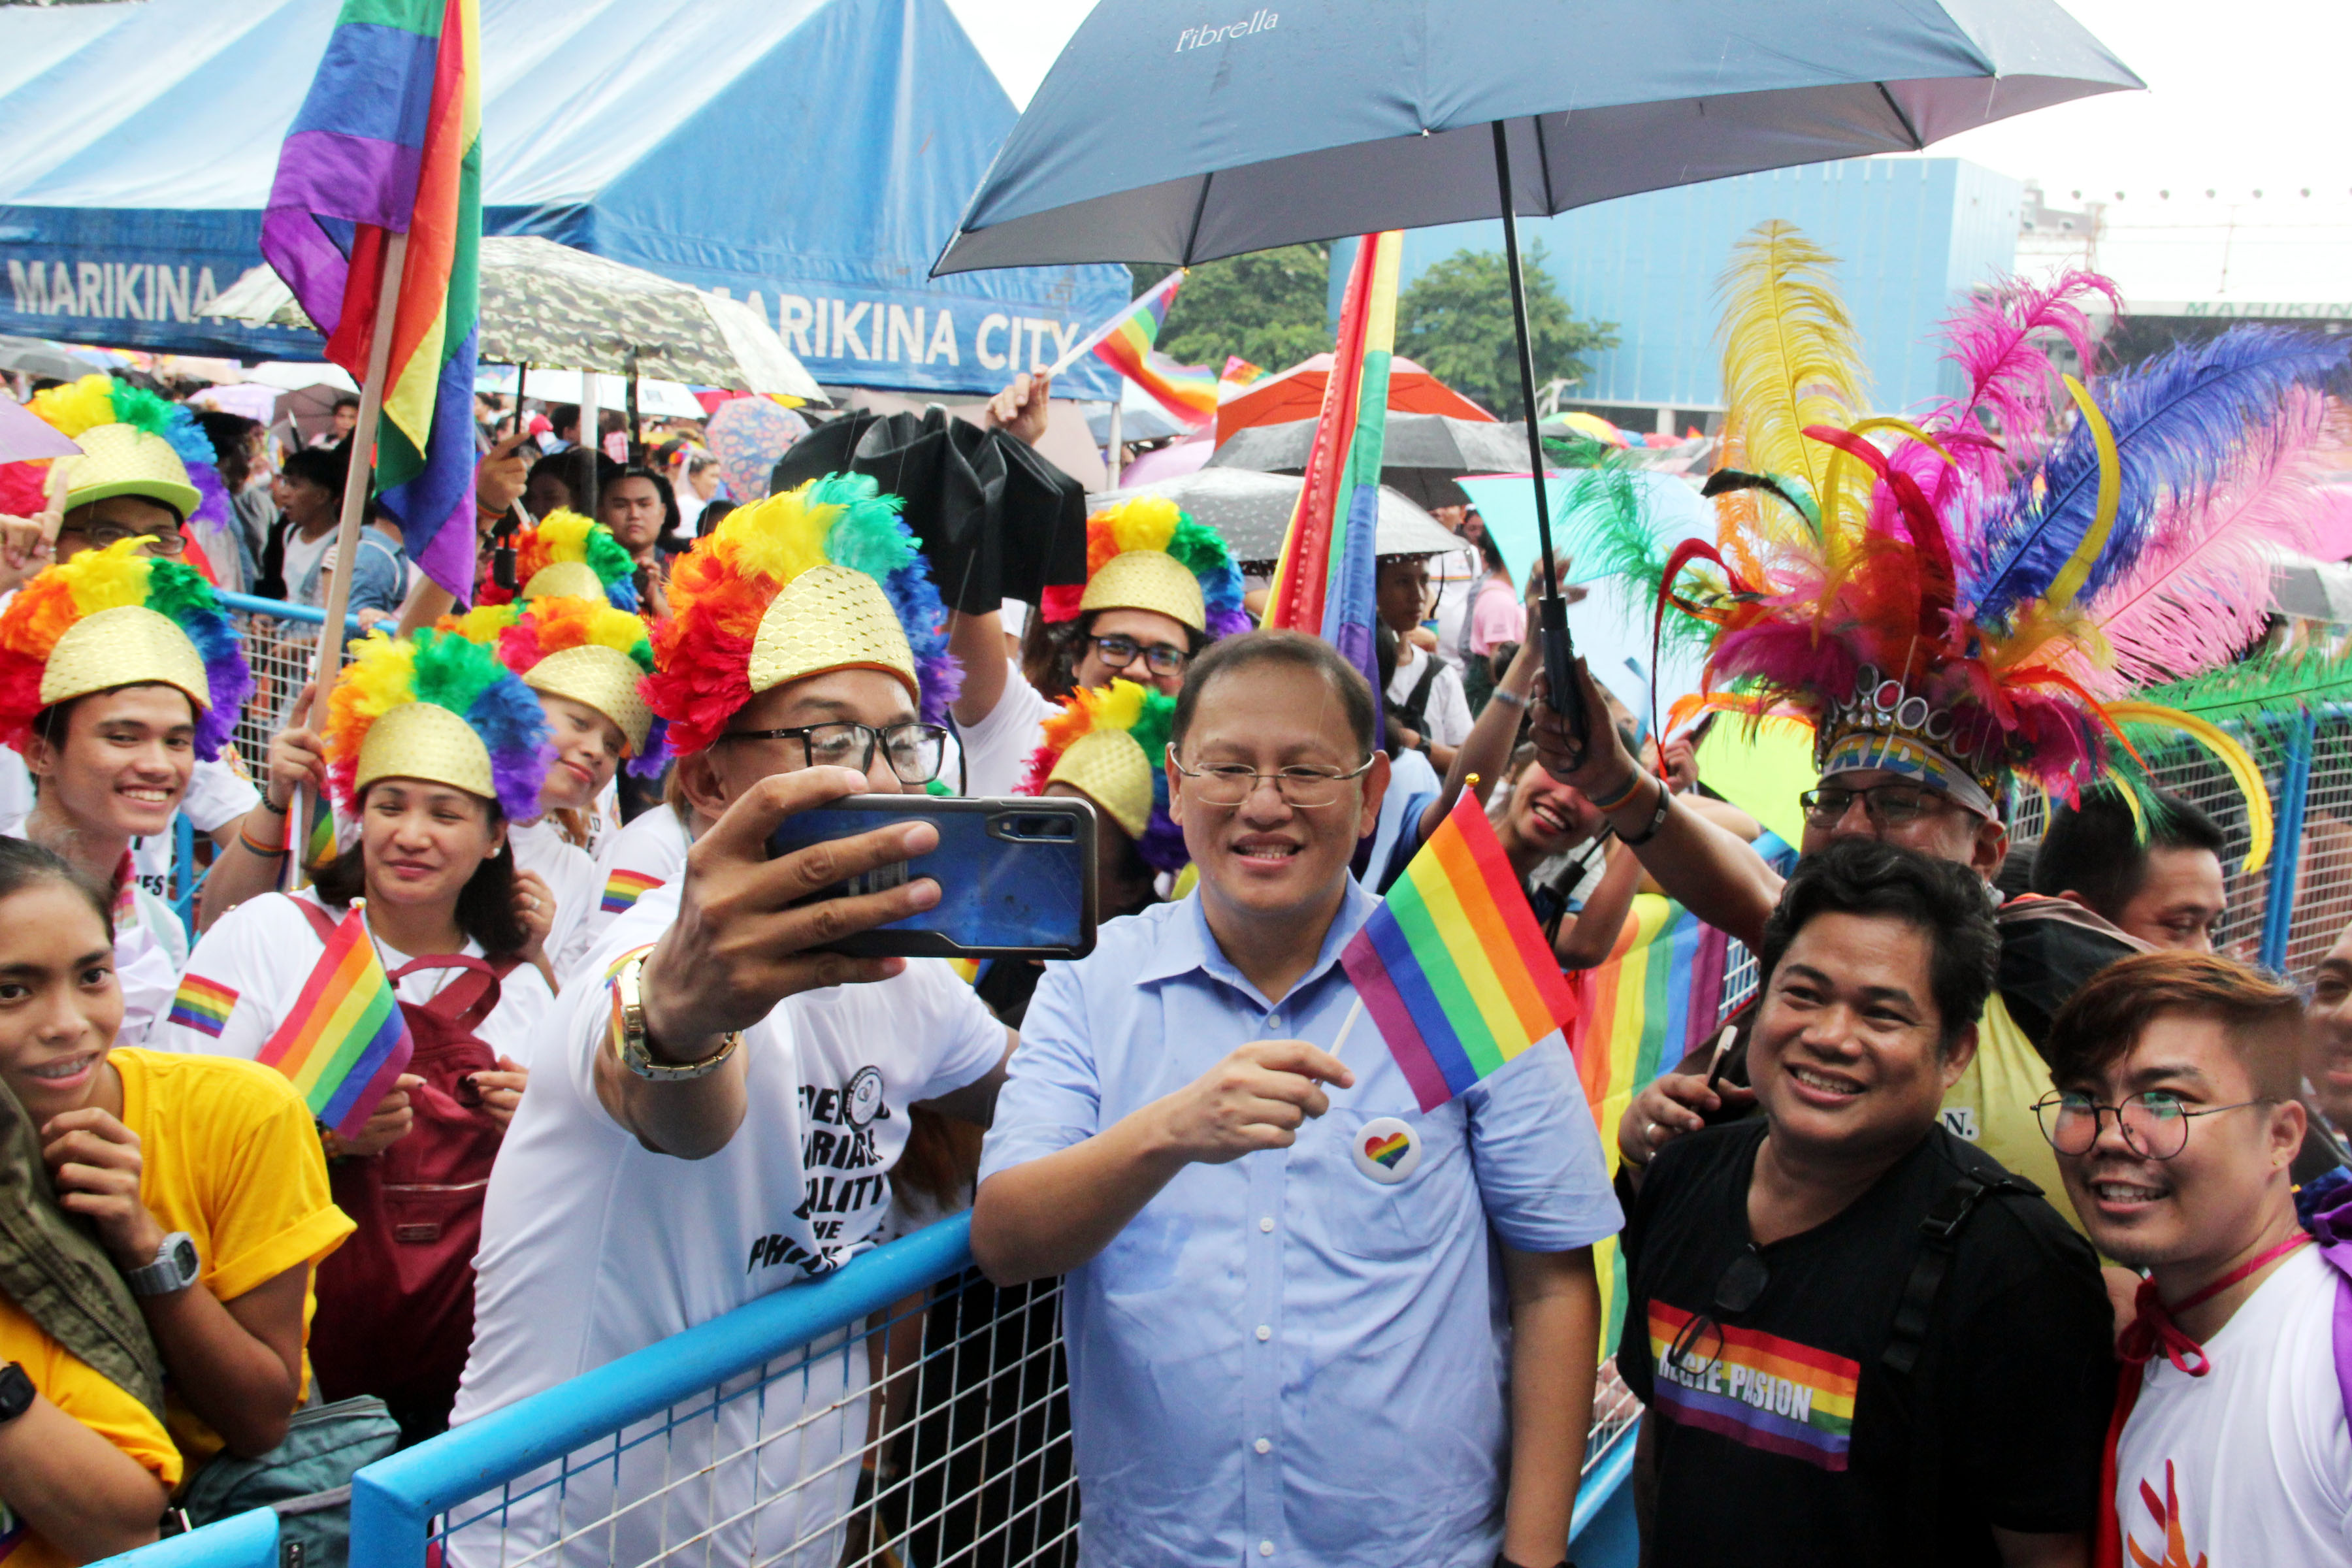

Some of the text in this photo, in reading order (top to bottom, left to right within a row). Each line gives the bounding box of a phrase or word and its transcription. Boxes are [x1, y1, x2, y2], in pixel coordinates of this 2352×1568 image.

[1175, 8, 1279, 53] Fibrella
[7, 259, 224, 325] MARIKINA
[713, 287, 1081, 375] RIKINA CITY
[1729, 1364, 1813, 1423] PASION
